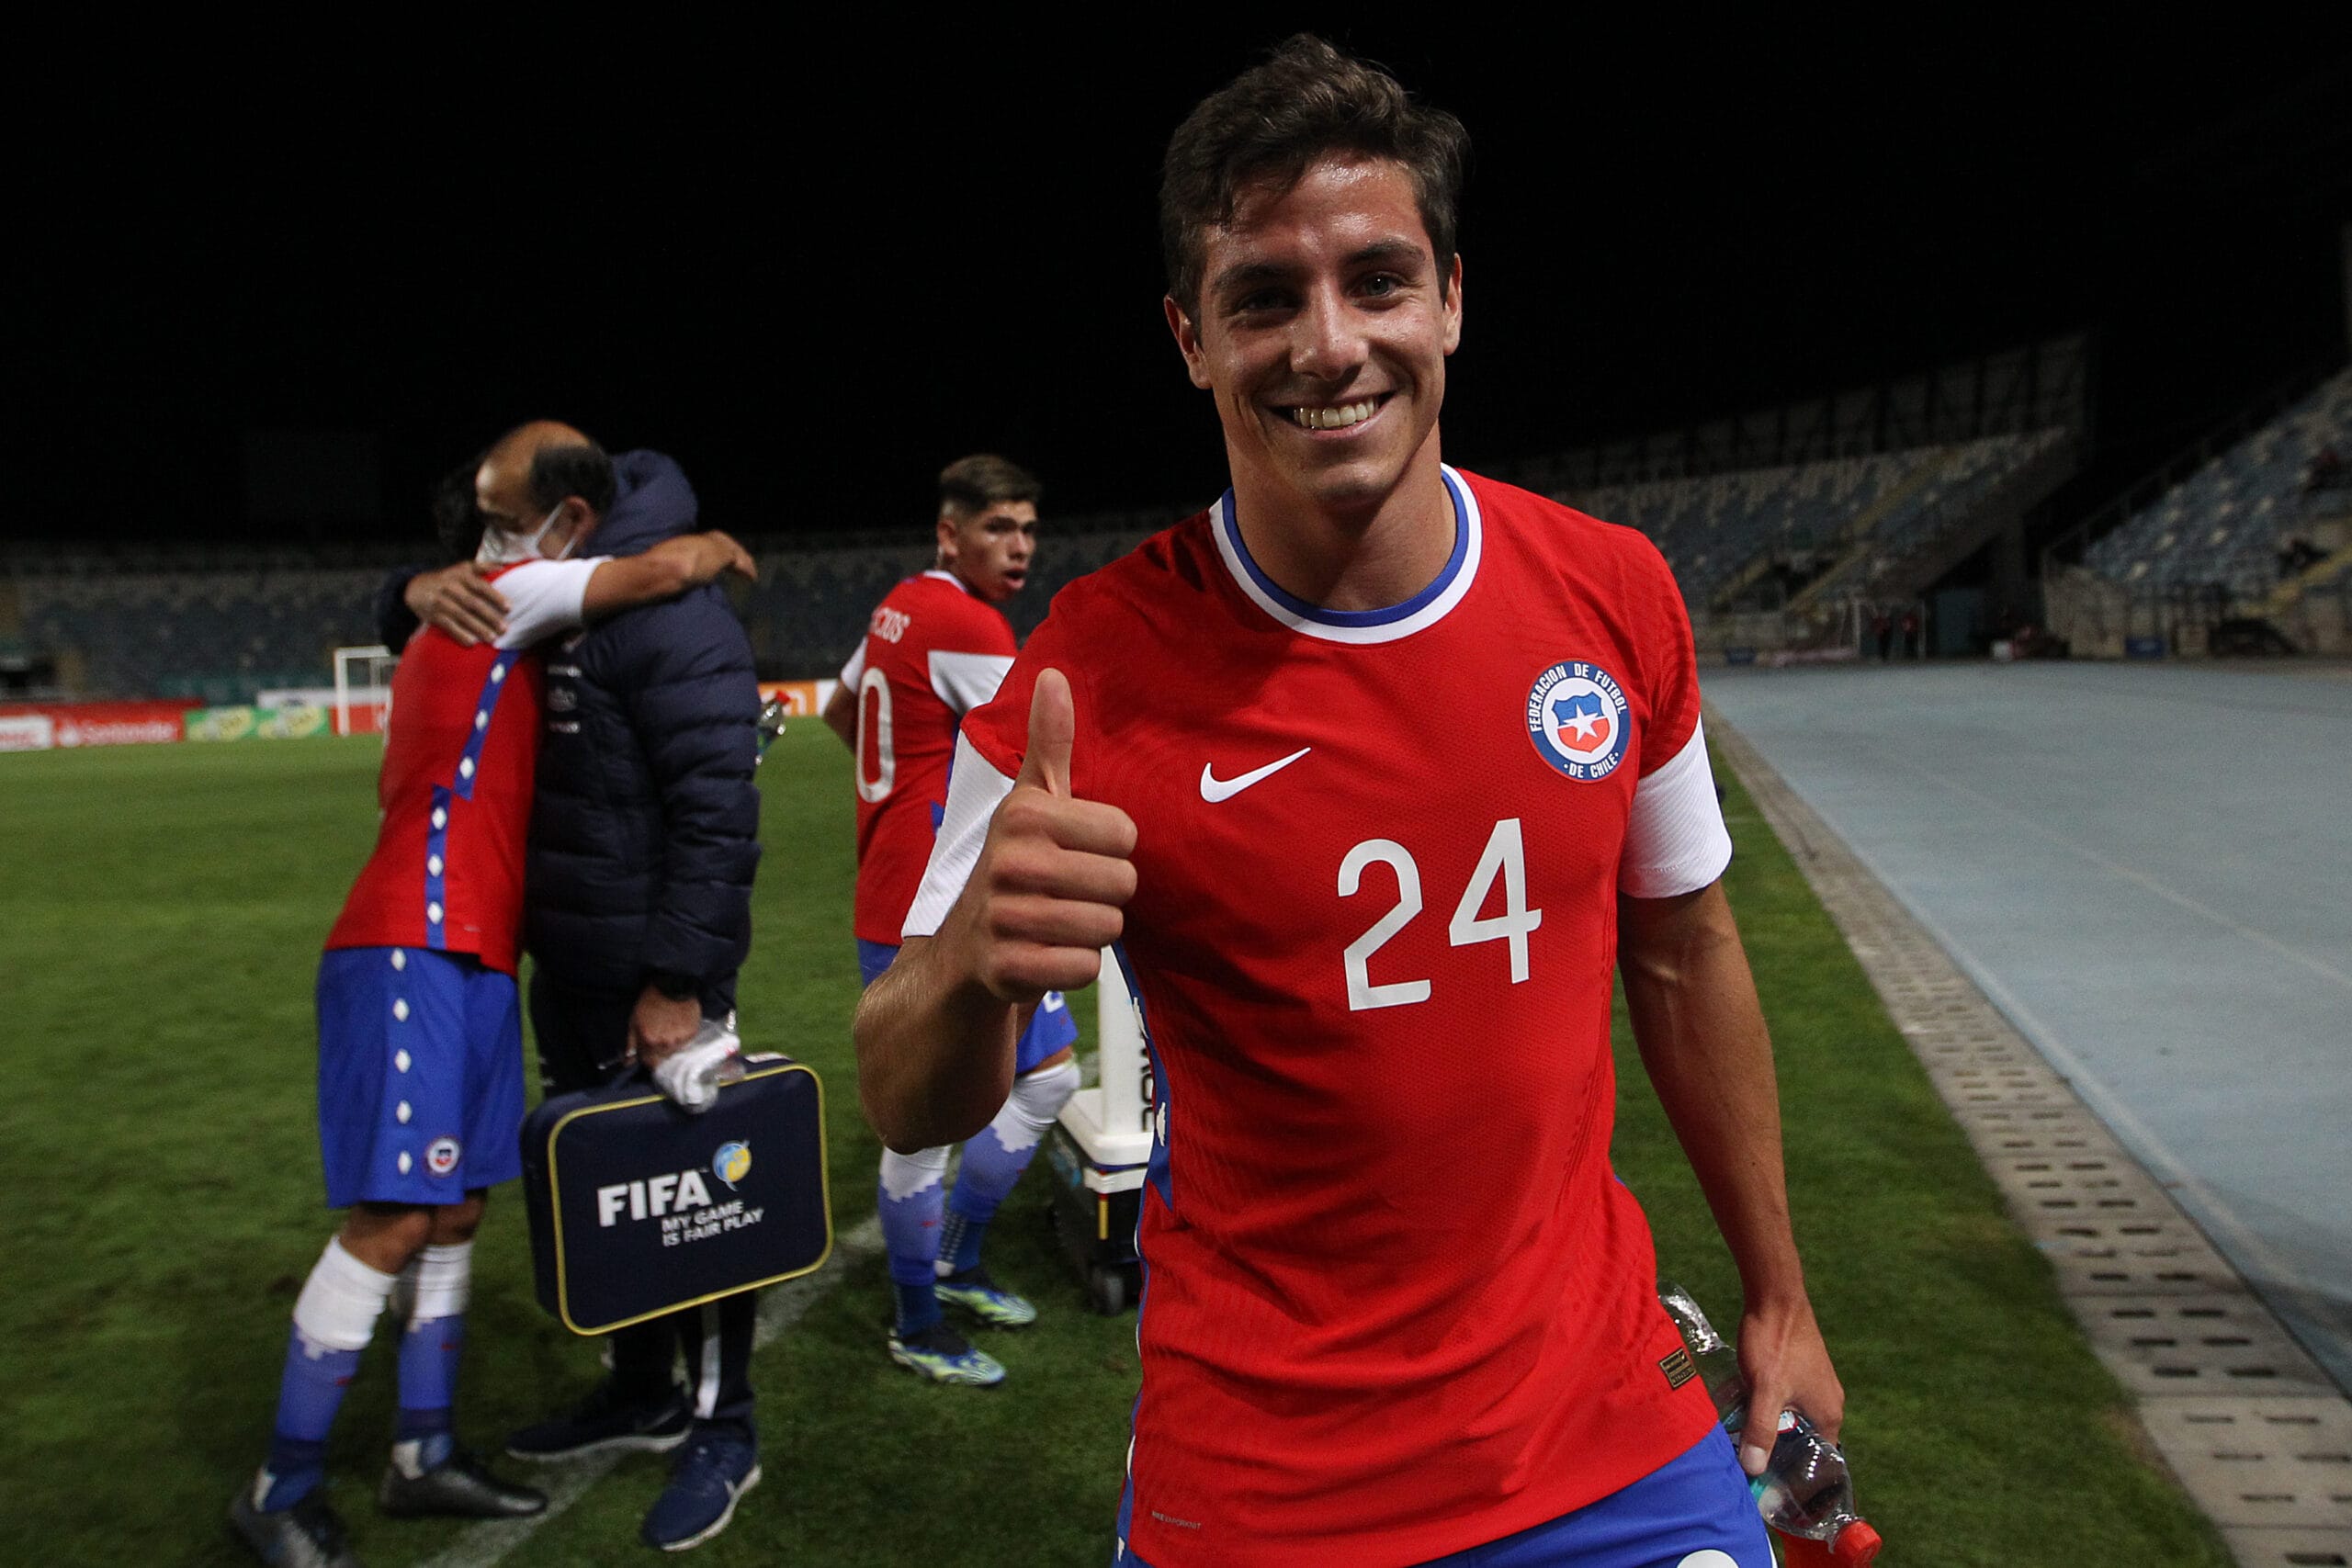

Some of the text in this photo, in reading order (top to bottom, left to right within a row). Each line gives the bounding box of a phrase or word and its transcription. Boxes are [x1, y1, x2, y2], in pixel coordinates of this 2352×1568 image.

[1529, 663, 1628, 732] FEDERACION DE FUTBOL
[1568, 753, 1618, 778] DE CHILE
[1338, 818, 1542, 1011] 24
[597, 1168, 712, 1228] FIFA
[662, 1199, 744, 1233] MY GAME
[662, 1207, 764, 1247] IS FAIR PLAY
